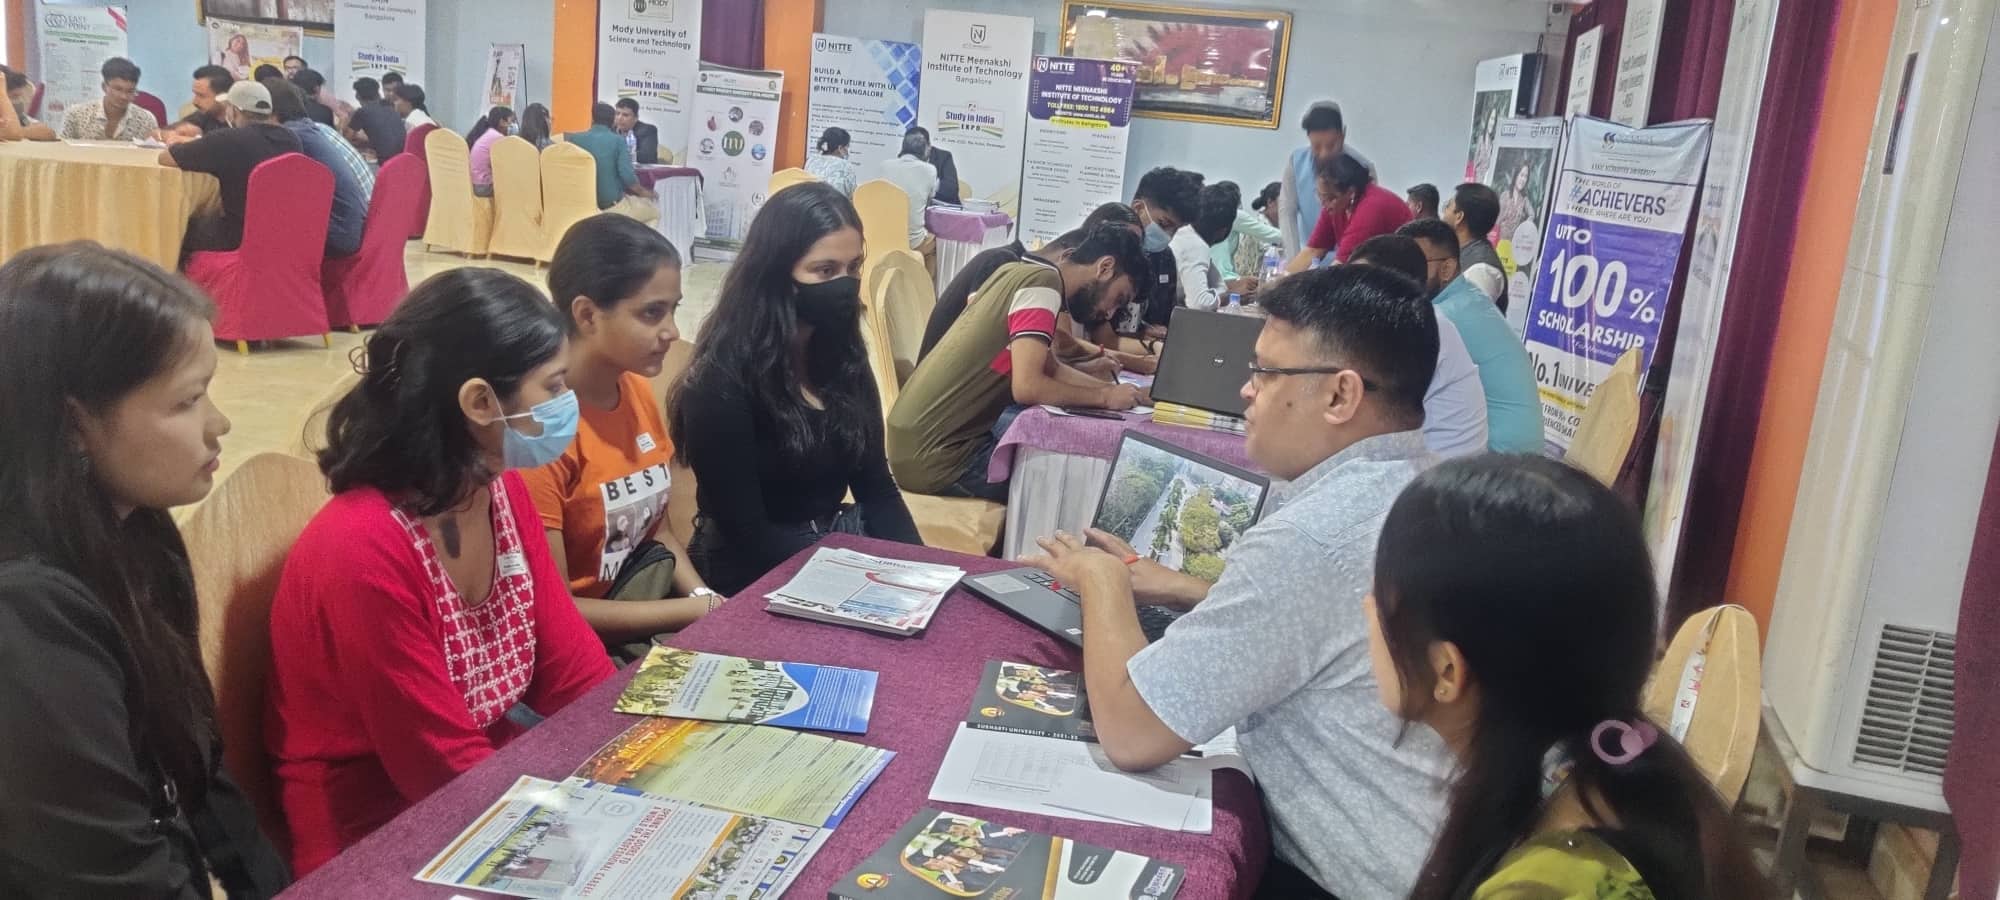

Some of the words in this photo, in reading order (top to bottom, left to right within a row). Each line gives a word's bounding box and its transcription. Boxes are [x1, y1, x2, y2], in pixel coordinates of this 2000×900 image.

[612, 24, 634, 34] Mody
[636, 26, 676, 39] University
[678, 30, 687, 38] of
[608, 34, 634, 43] Science
[636, 37, 650, 45] and
[652, 38, 691, 50] Technology
[828, 42, 853, 52] NITTE
[633, 46, 667, 55] Rajasthan
[940, 53, 964, 64] NITTE
[967, 56, 1011, 68] Meenakshi
[1050, 62, 1075, 71] NITTE
[814, 67, 834, 75] BUILD
[927, 62, 961, 73] Institute
[963, 66, 973, 74] of
[975, 66, 1023, 80] Technology
[625, 78, 643, 89] Study
[652, 81, 670, 91] India
[814, 75, 839, 84] BETTER
[841, 78, 866, 88] FUTURE
[868, 81, 886, 90] WITH
[888, 83, 897, 91] US
[955, 75, 992, 86] Bangalore
[843, 88, 883, 98] BANGALORE
[1055, 84, 1072, 92] NITTE
[1041, 91, 1070, 100] INSTITUTE
[1081, 95, 1122, 104] TECHNOLOGY
[945, 111, 967, 122] Study
[967, 113, 975, 121] in
[976, 114, 995, 124] India
[1575, 176, 1589, 186] THE
[1591, 180, 1612, 188] WORLD
[1568, 184, 1666, 216] #ACHIEVERS
[1596, 210, 1617, 219] WHERE
[1618, 212, 1632, 220] ARE
[1537, 309, 1645, 350] SCHOLARSHIP
[606, 463, 669, 502] BEST
[1008, 727, 1045, 736] UNIVERSITY
[639, 811, 658, 827] WORLD
[640, 828, 655, 839] THE
[625, 839, 646, 856] DOORS
[618, 857, 632, 865] TO
